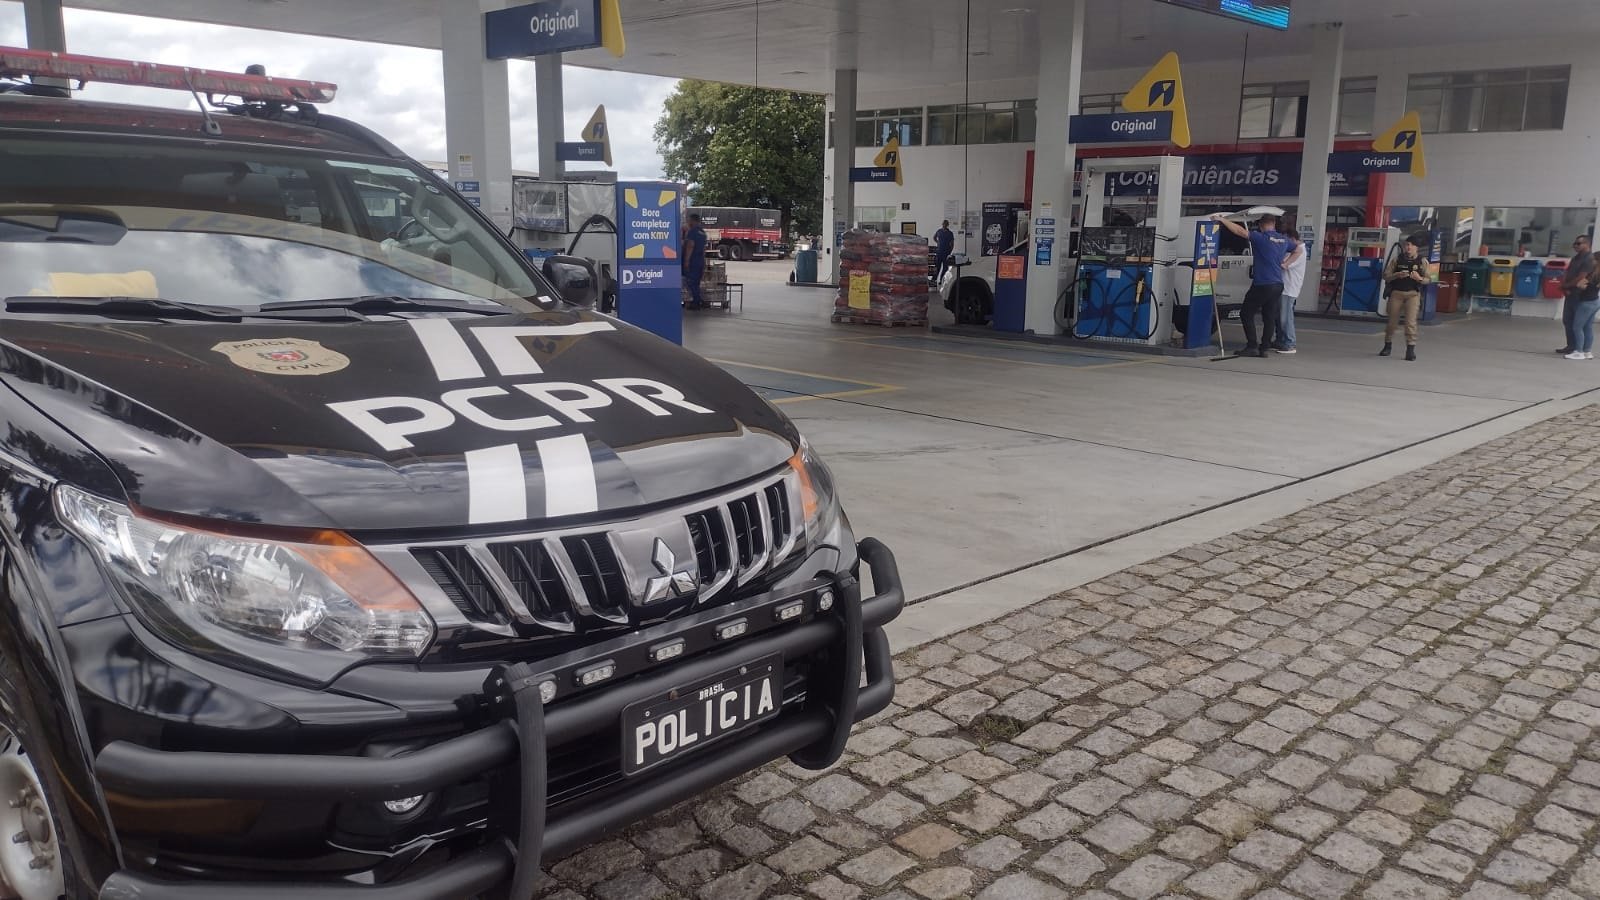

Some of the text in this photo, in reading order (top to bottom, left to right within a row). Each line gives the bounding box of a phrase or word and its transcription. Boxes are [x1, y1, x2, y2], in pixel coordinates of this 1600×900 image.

[530, 9, 579, 36] Original
[1111, 118, 1157, 134] Original
[1362, 157, 1400, 168] Original
[1119, 164, 1280, 185] Conniências
[641, 208, 660, 217] Bora
[631, 219, 671, 230] completar
[633, 231, 670, 240] com KMV
[622, 269, 634, 285] D
[636, 269, 663, 279] Original
[276, 362, 328, 371] CIVIL
[326, 377, 715, 452] PCPR
[699, 683, 725, 701] BRASIL
[636, 678, 773, 765] POLICIA
